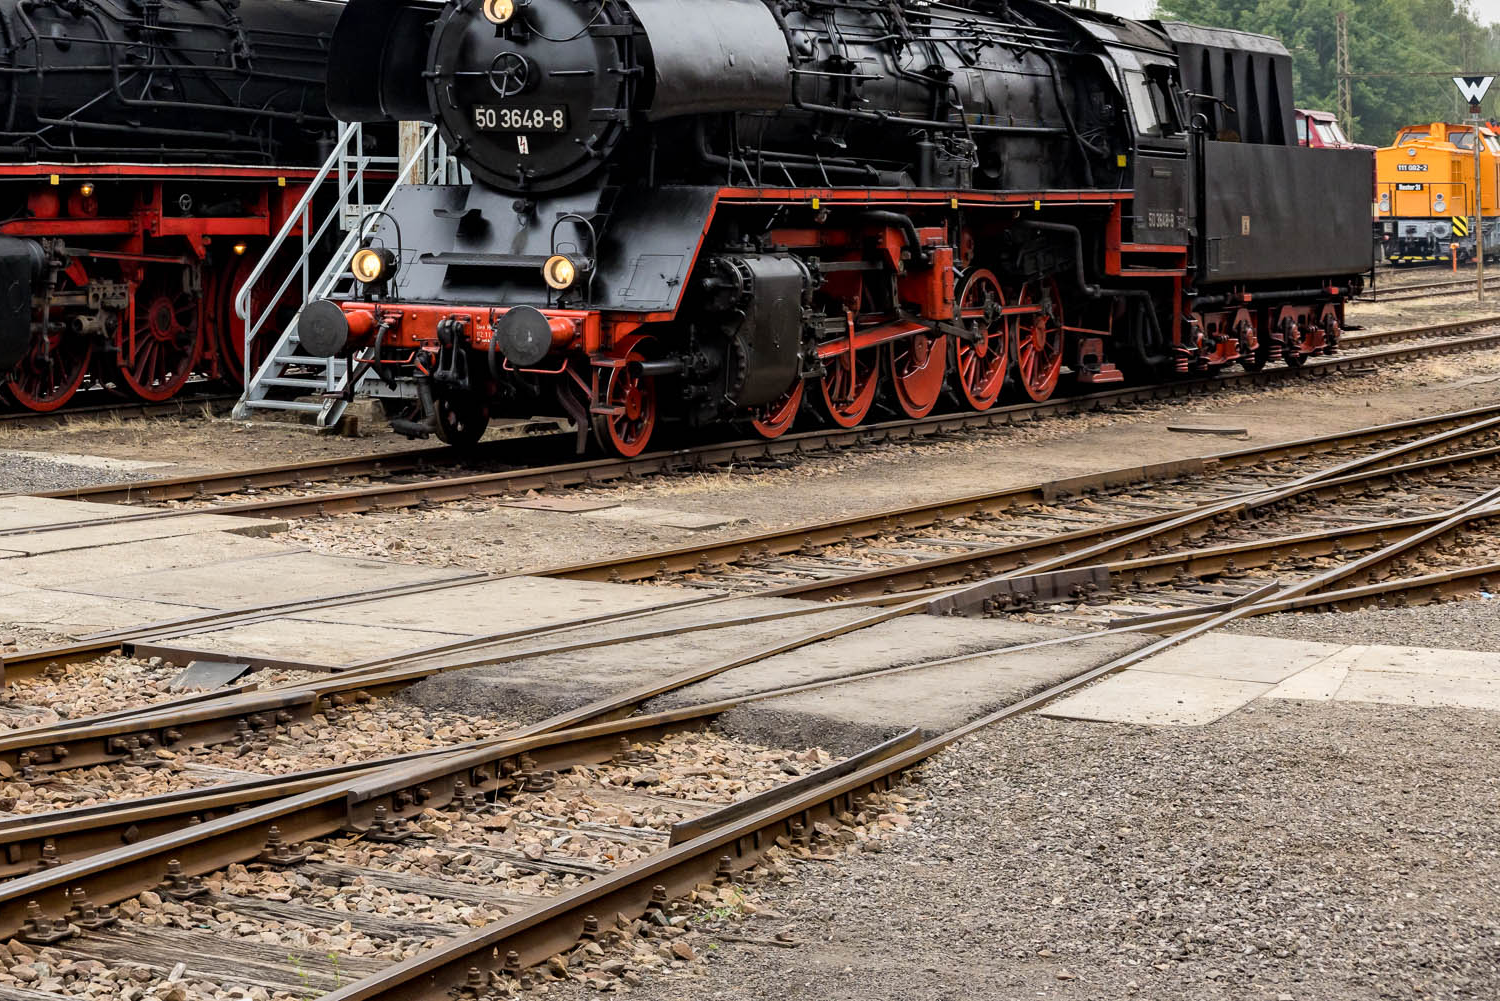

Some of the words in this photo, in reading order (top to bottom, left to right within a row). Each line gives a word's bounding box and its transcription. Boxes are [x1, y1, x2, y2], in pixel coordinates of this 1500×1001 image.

[1452, 77, 1494, 102] W
[475, 108, 496, 128] 50
[500, 108, 564, 128] 3648-8
